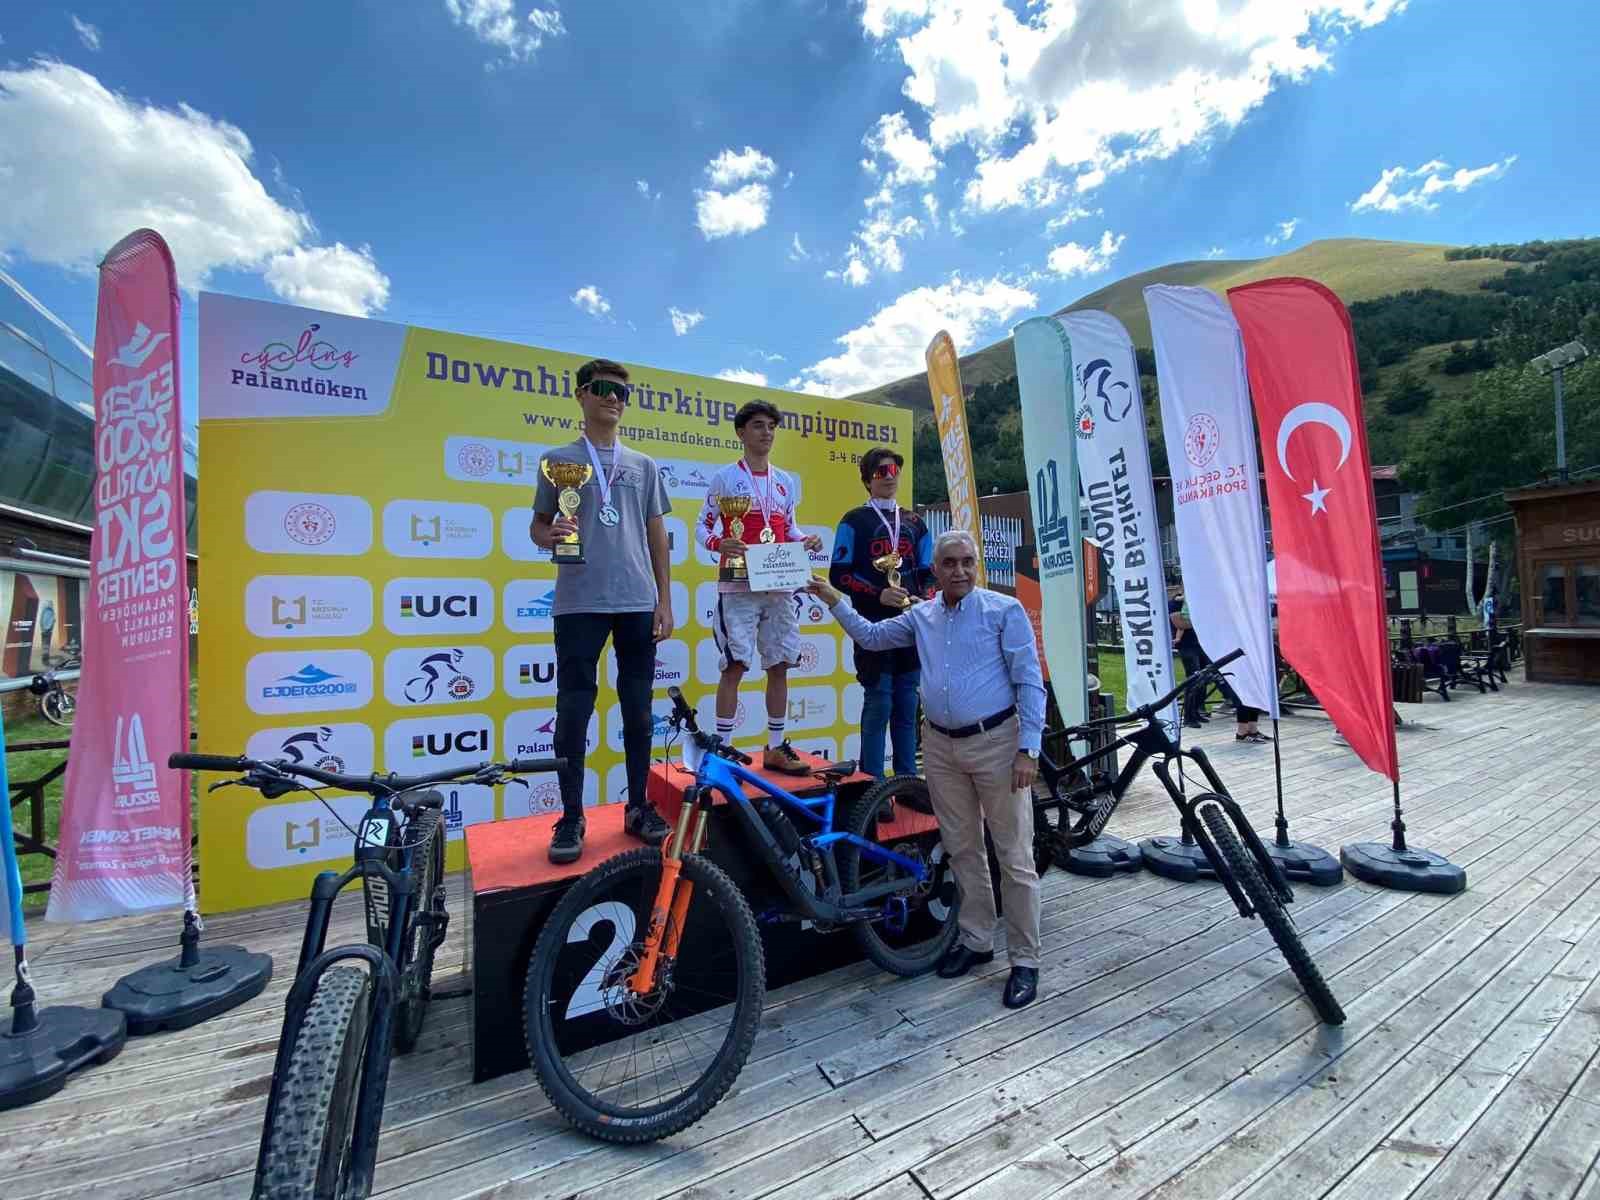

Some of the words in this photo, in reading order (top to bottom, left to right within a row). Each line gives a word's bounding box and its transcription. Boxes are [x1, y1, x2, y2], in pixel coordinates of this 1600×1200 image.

[231, 368, 368, 401] Palandöken
[426, 351, 573, 399] Downhi
[778, 411, 899, 444] mpiyonası
[415, 595, 477, 618] UCI
[427, 729, 488, 756] UCI
[565, 901, 637, 1020] 2
